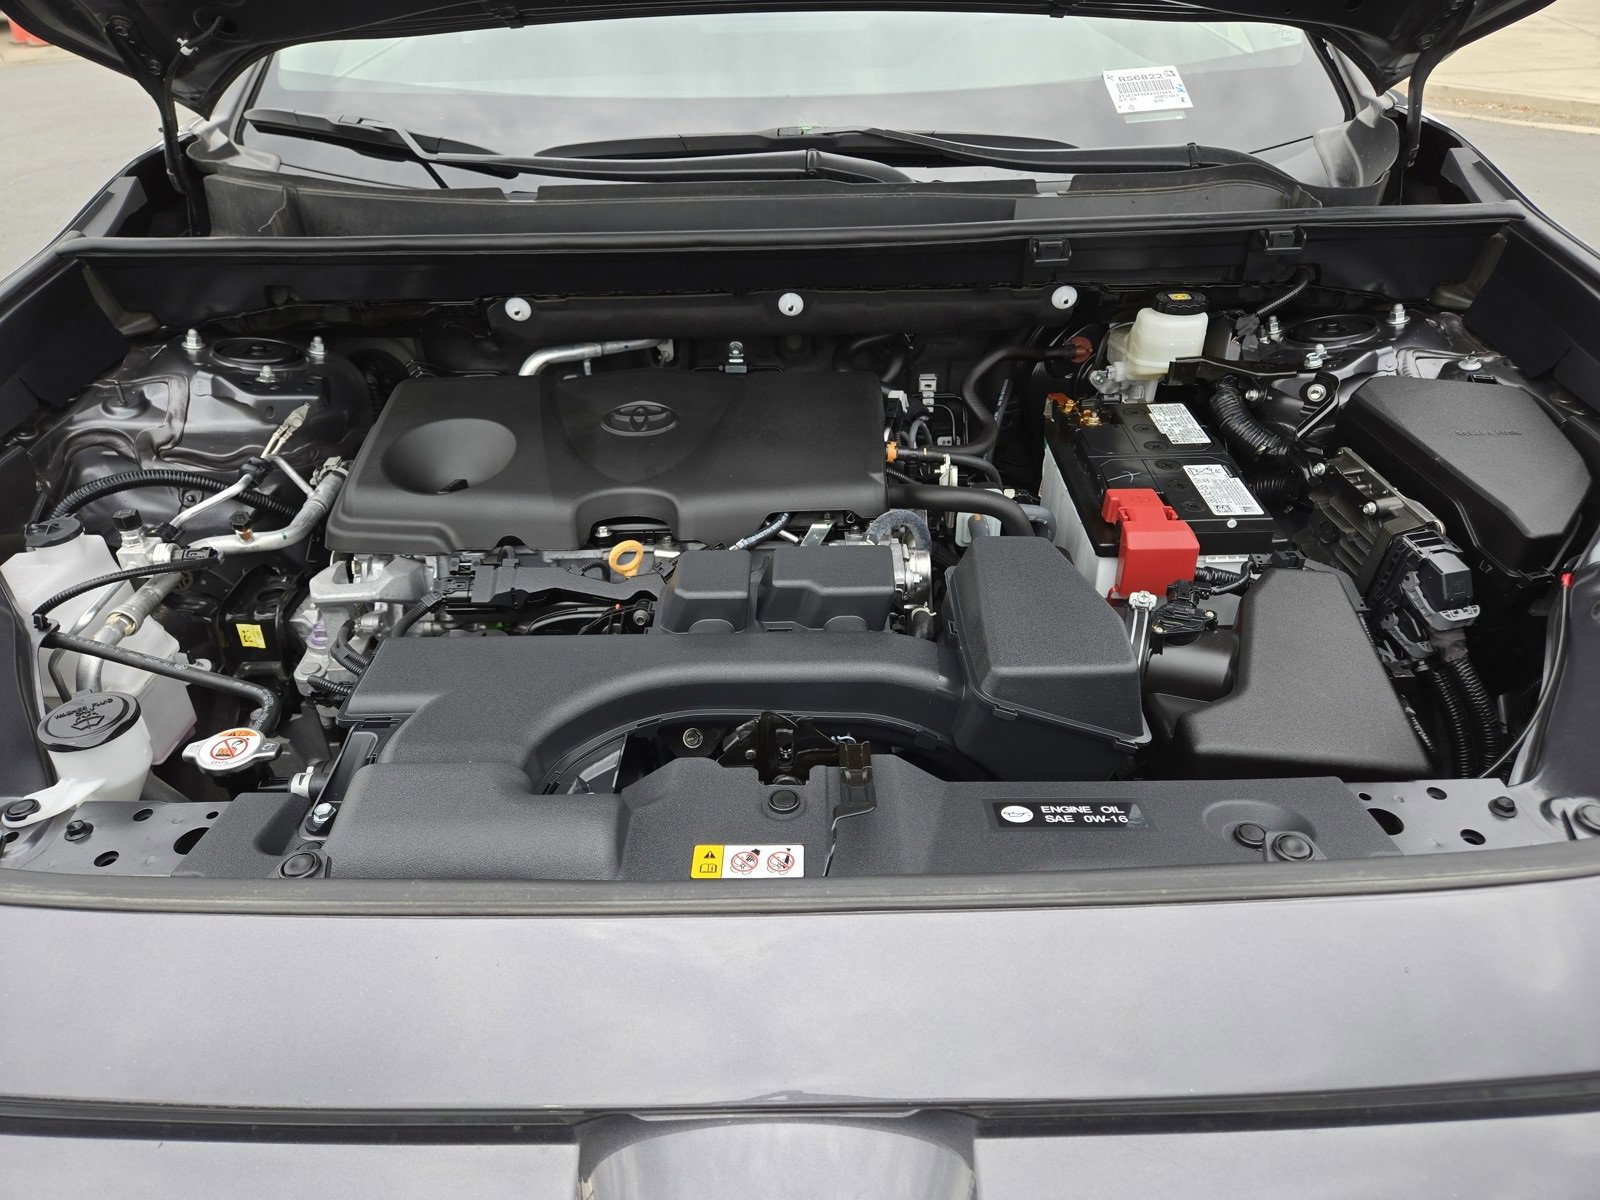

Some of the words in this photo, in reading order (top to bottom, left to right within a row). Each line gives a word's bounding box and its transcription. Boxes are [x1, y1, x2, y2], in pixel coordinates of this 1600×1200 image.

[1118, 73, 1163, 82] RS6822
[54, 706, 87, 720] WASHER
[92, 698, 114, 708] FLUID
[1040, 805, 1093, 814] ENGINE
[1100, 805, 1125, 814] OIL
[1045, 815, 1075, 823] SAE
[1084, 815, 1129, 823] 0W-16
